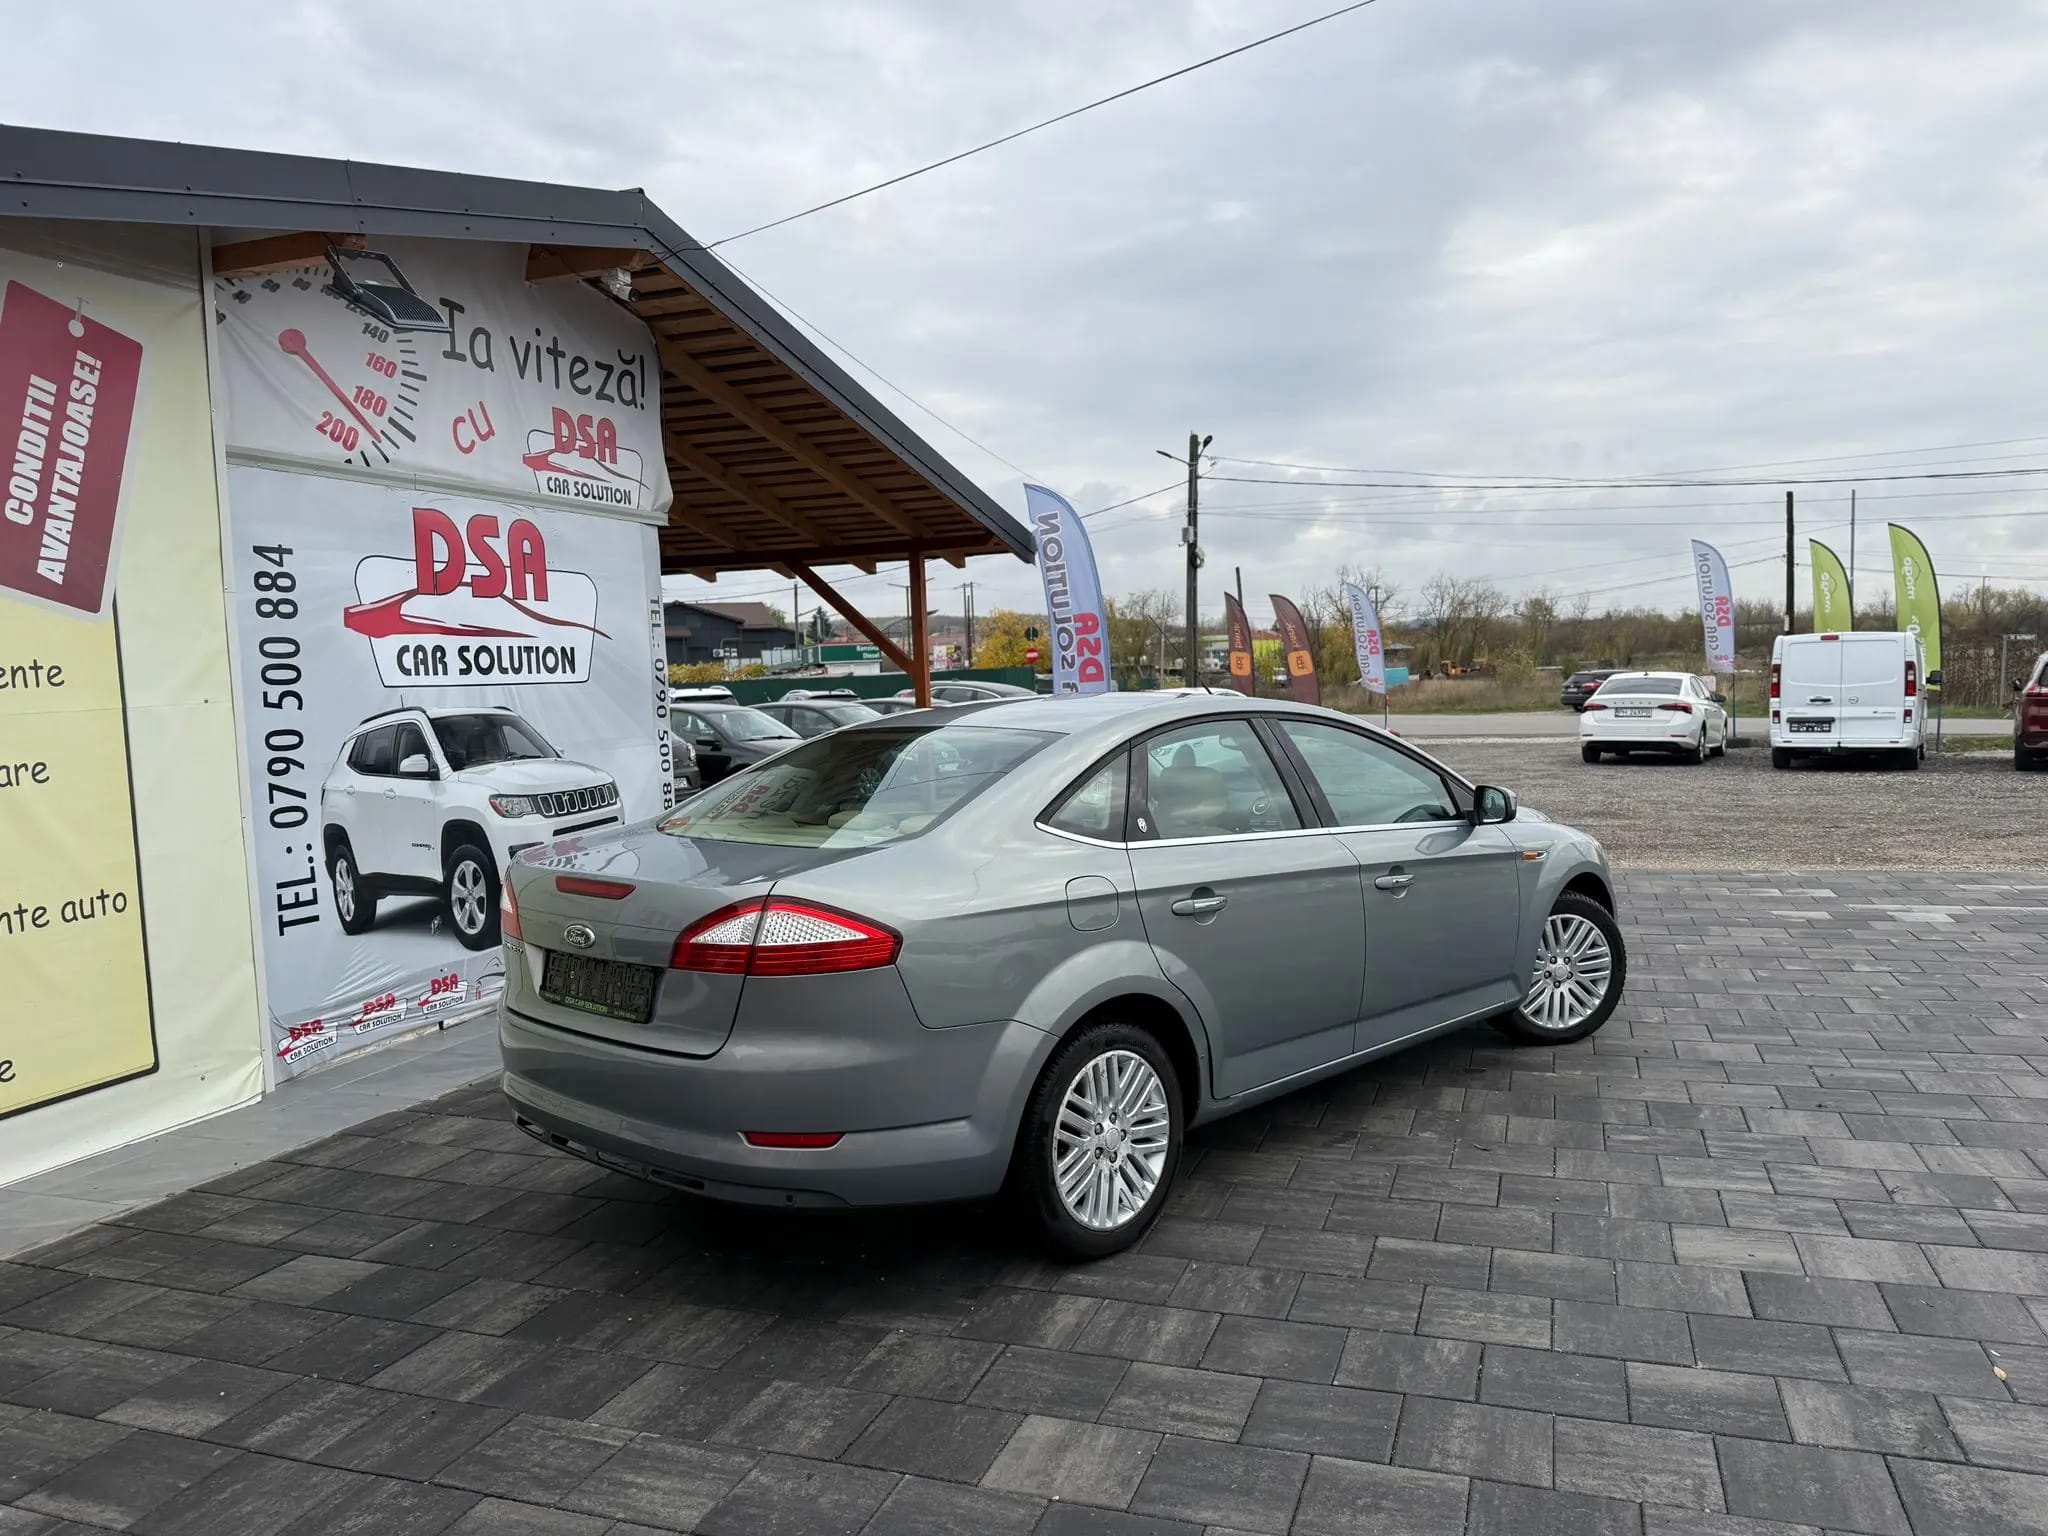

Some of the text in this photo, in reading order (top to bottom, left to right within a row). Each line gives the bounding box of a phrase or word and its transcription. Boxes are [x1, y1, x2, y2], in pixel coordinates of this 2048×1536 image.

[361, 322, 390, 343] 140
[365, 352, 397, 378] 160
[509, 327, 645, 410] viteză!
[353, 385, 387, 417] 180
[315, 410, 359, 452] 200
[452, 400, 496, 454] cu
[551, 406, 617, 464] DSA
[5, 373, 57, 526] CONDITII
[36, 349, 102, 585] AVANTAJOASE!
[546, 476, 632, 506] CAR SOLUTION
[412, 507, 548, 602] DSA
[396, 644, 576, 677] CAR SOLUTION
[654, 658, 668, 719] 0790
[253, 544, 320, 936] TEL.: 0790 500 884
[657, 729, 671, 773] 500
[61, 889, 128, 923] auto
[568, 929, 586, 944] Ford
[431, 973, 458, 995] DSA
[359, 1013, 402, 1031] CAR SOLUTION
[303, 1036, 333, 1054] SOLUTION
